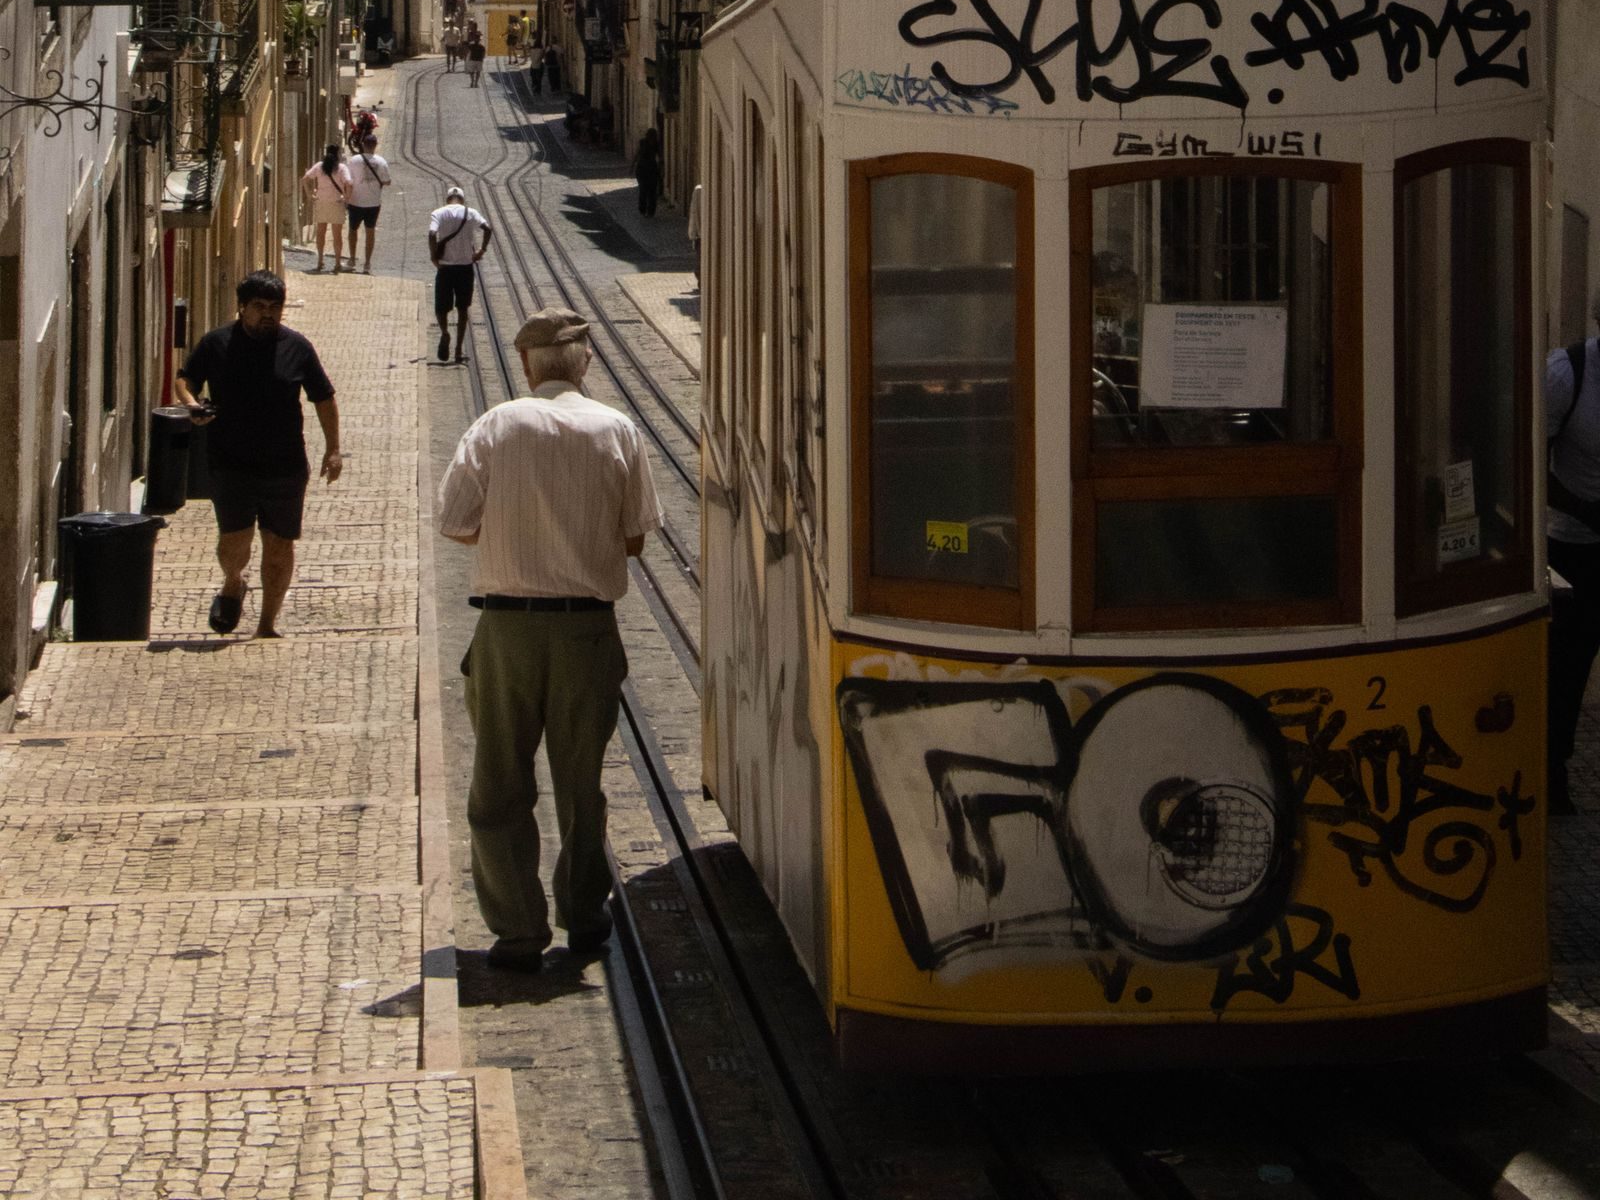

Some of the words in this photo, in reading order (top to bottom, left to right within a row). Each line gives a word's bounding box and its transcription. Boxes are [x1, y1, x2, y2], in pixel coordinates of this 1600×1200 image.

[927, 534, 961, 551] 4.20
[1441, 537, 1466, 551] 4.20
[1366, 676, 1387, 710] 2
